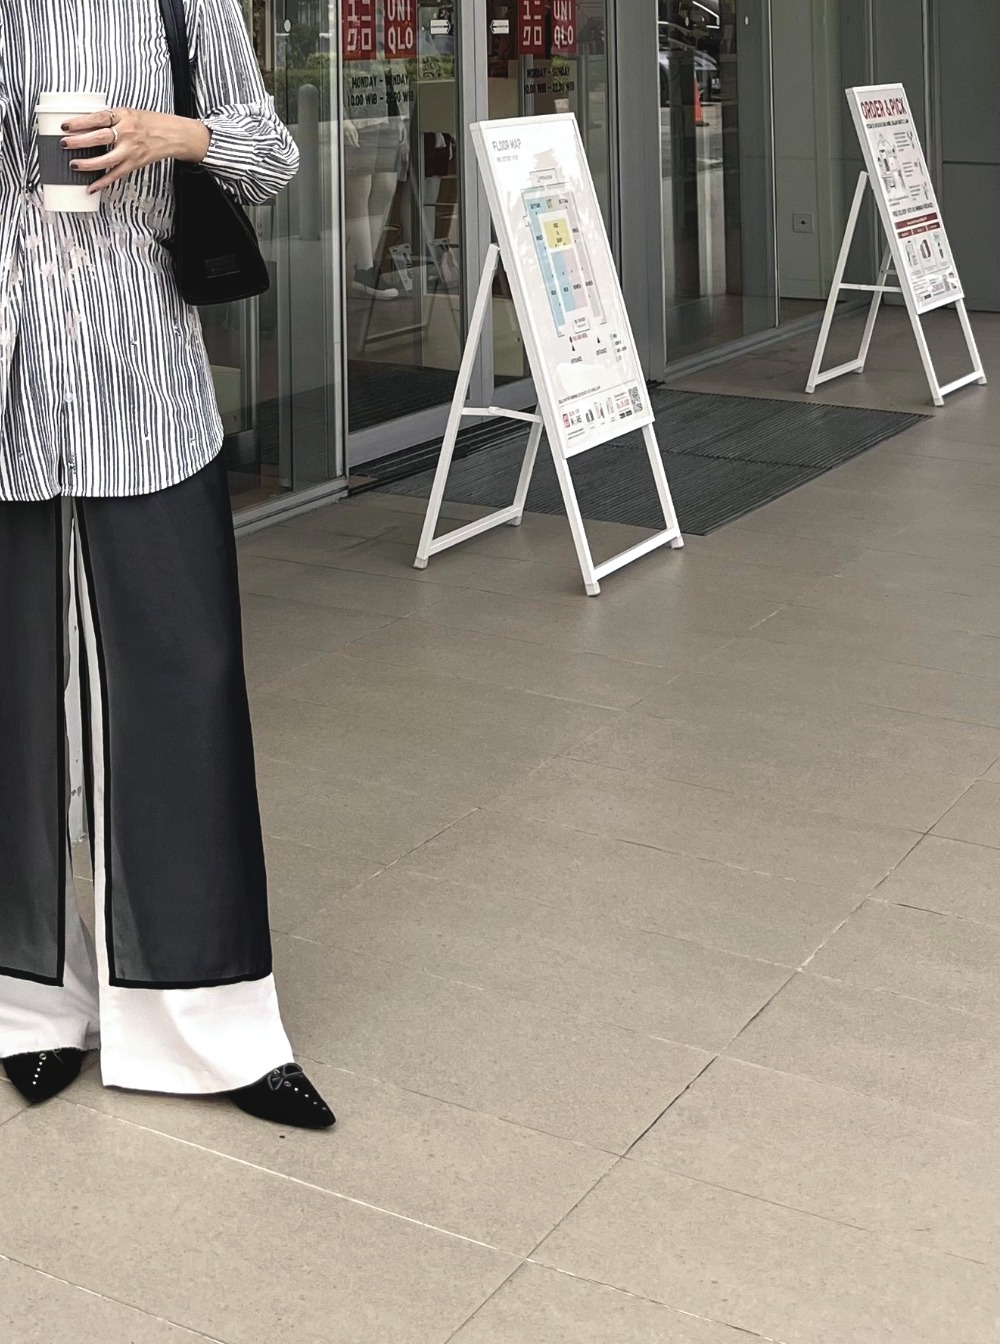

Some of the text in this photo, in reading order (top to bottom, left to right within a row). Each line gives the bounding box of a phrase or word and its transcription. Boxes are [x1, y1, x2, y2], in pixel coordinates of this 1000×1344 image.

[523, 0, 542, 20] ユニ
[553, 0, 572, 21] UNI
[388, 26, 413, 54] QLO
[554, 25, 574, 49] QLO
[351, 76, 377, 89] MONDAY
[347, 95, 364, 107] 10.00
[365, 93, 378, 105] WIB
[860, 97, 907, 120] ORDER & PICK
